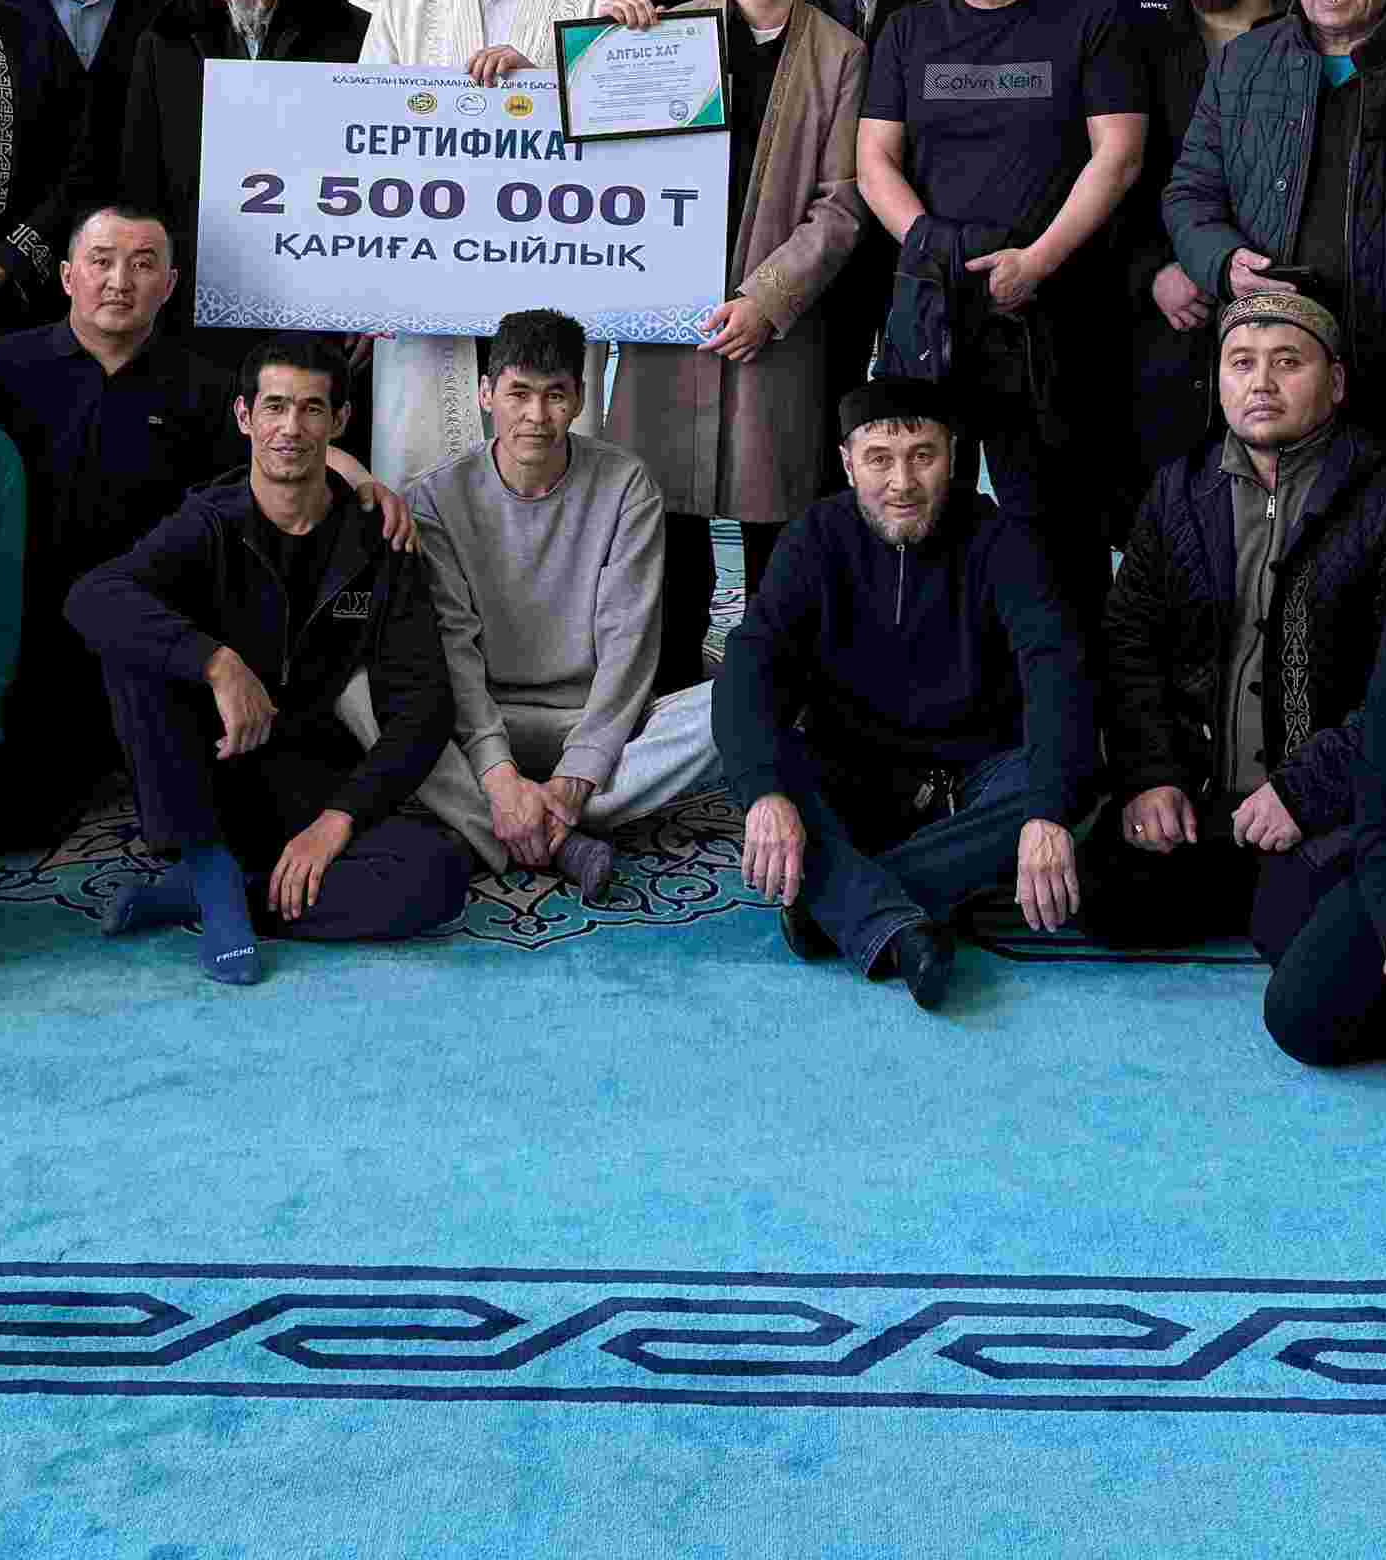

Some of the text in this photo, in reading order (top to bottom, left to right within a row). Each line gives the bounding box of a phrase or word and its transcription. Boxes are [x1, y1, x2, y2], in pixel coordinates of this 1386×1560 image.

[240, 173, 285, 214] 2
[316, 176, 465, 220] 500
[496, 182, 646, 226] 000
[274, 233, 646, 273] ҚАРИҒА СЫЙЛЫҚ
